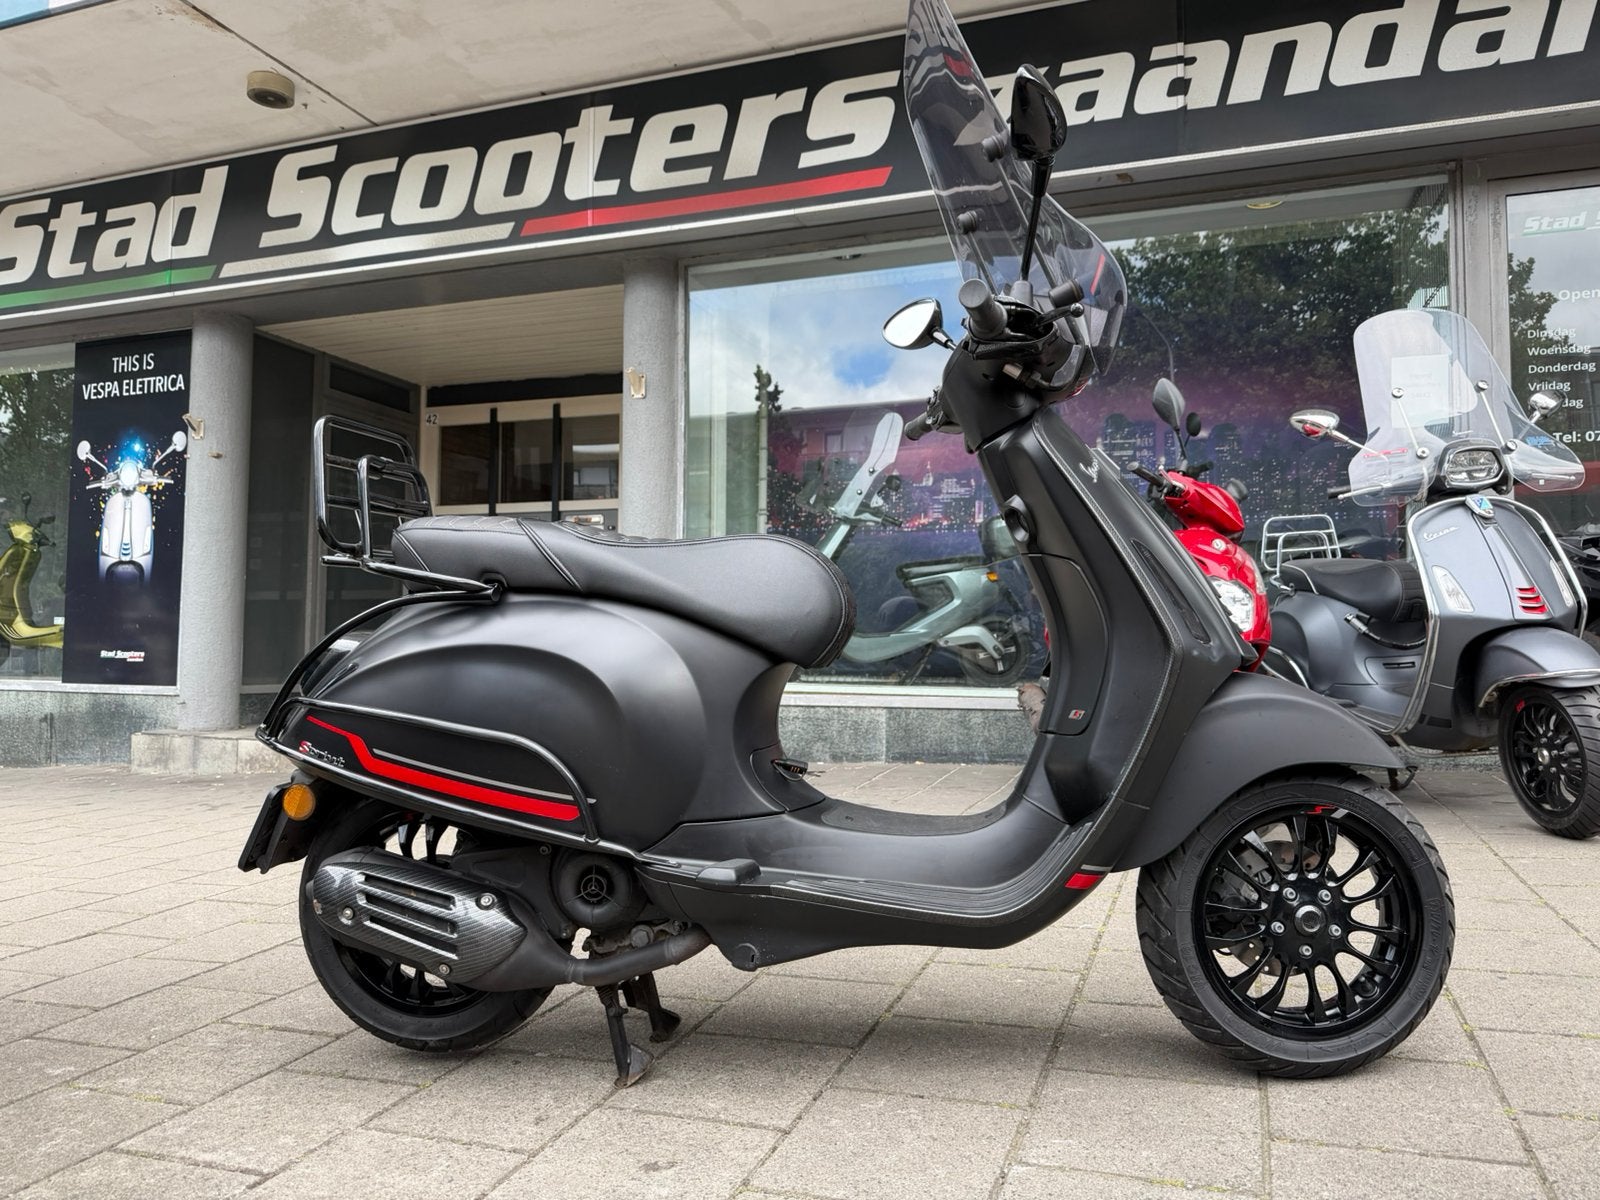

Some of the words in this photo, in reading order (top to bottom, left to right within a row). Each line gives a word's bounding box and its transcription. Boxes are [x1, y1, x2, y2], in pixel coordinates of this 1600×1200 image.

[0, 165, 229, 286] Stad
[258, 69, 901, 248] Scooters
[1523, 211, 1588, 232] Stad
[1527, 327, 1577, 339] Dinsdag
[1527, 343, 1592, 357] Woensdag
[112, 354, 140, 374] THIS
[143, 353, 155, 371] IS
[1528, 361, 1597, 374] Donderdag
[82, 380, 120, 401] VESPA
[122, 374, 185, 396] ELETTRICA
[426, 414, 438, 425] 42
[1552, 430, 1582, 443] Tel:
